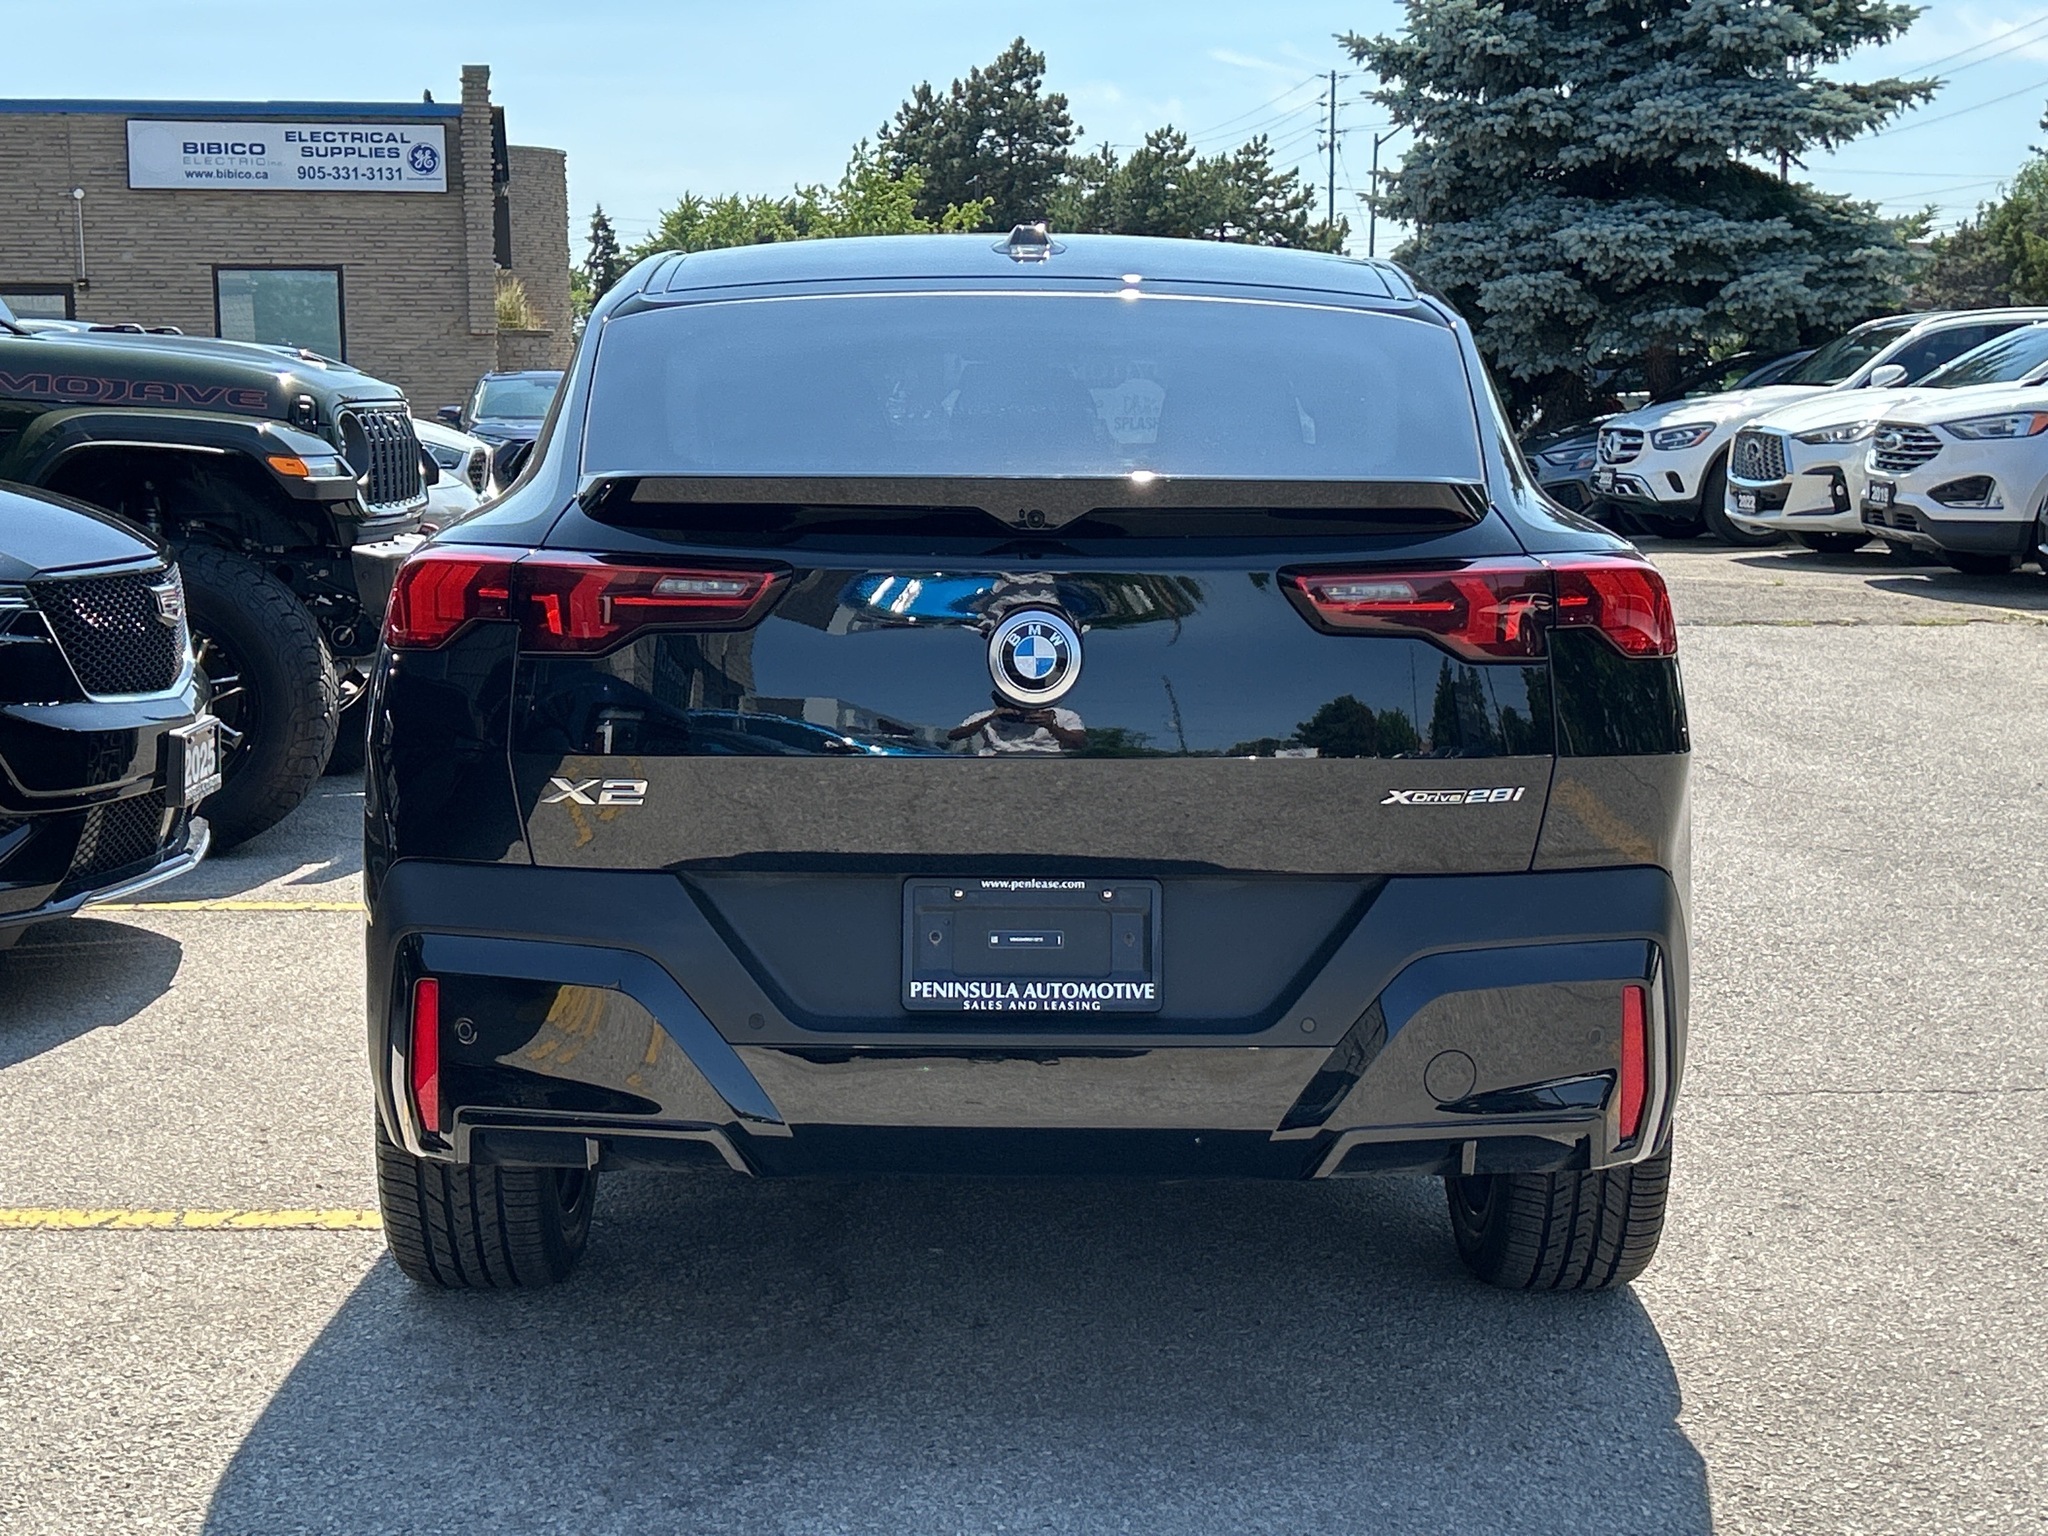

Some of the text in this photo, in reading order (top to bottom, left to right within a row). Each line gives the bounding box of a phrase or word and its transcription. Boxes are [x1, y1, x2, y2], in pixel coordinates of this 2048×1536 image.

[285, 131, 411, 144] ELECTRICAL
[182, 142, 266, 155] BIBICO
[301, 146, 401, 159] SUPPLIES
[185, 169, 269, 180] www.bibico.ca
[297, 166, 403, 181] 905-331-3131
[0, 371, 268, 410] MOJAVE
[1006, 624, 1064, 647] BMW
[185, 737, 216, 788] 2025
[540, 777, 649, 805] X2
[981, 879, 1086, 891] www.penlease.com
[910, 982, 1155, 1000] PENINSULA AUTOMOTIVE
[963, 1000, 1101, 1011] SALES AND LEASING
